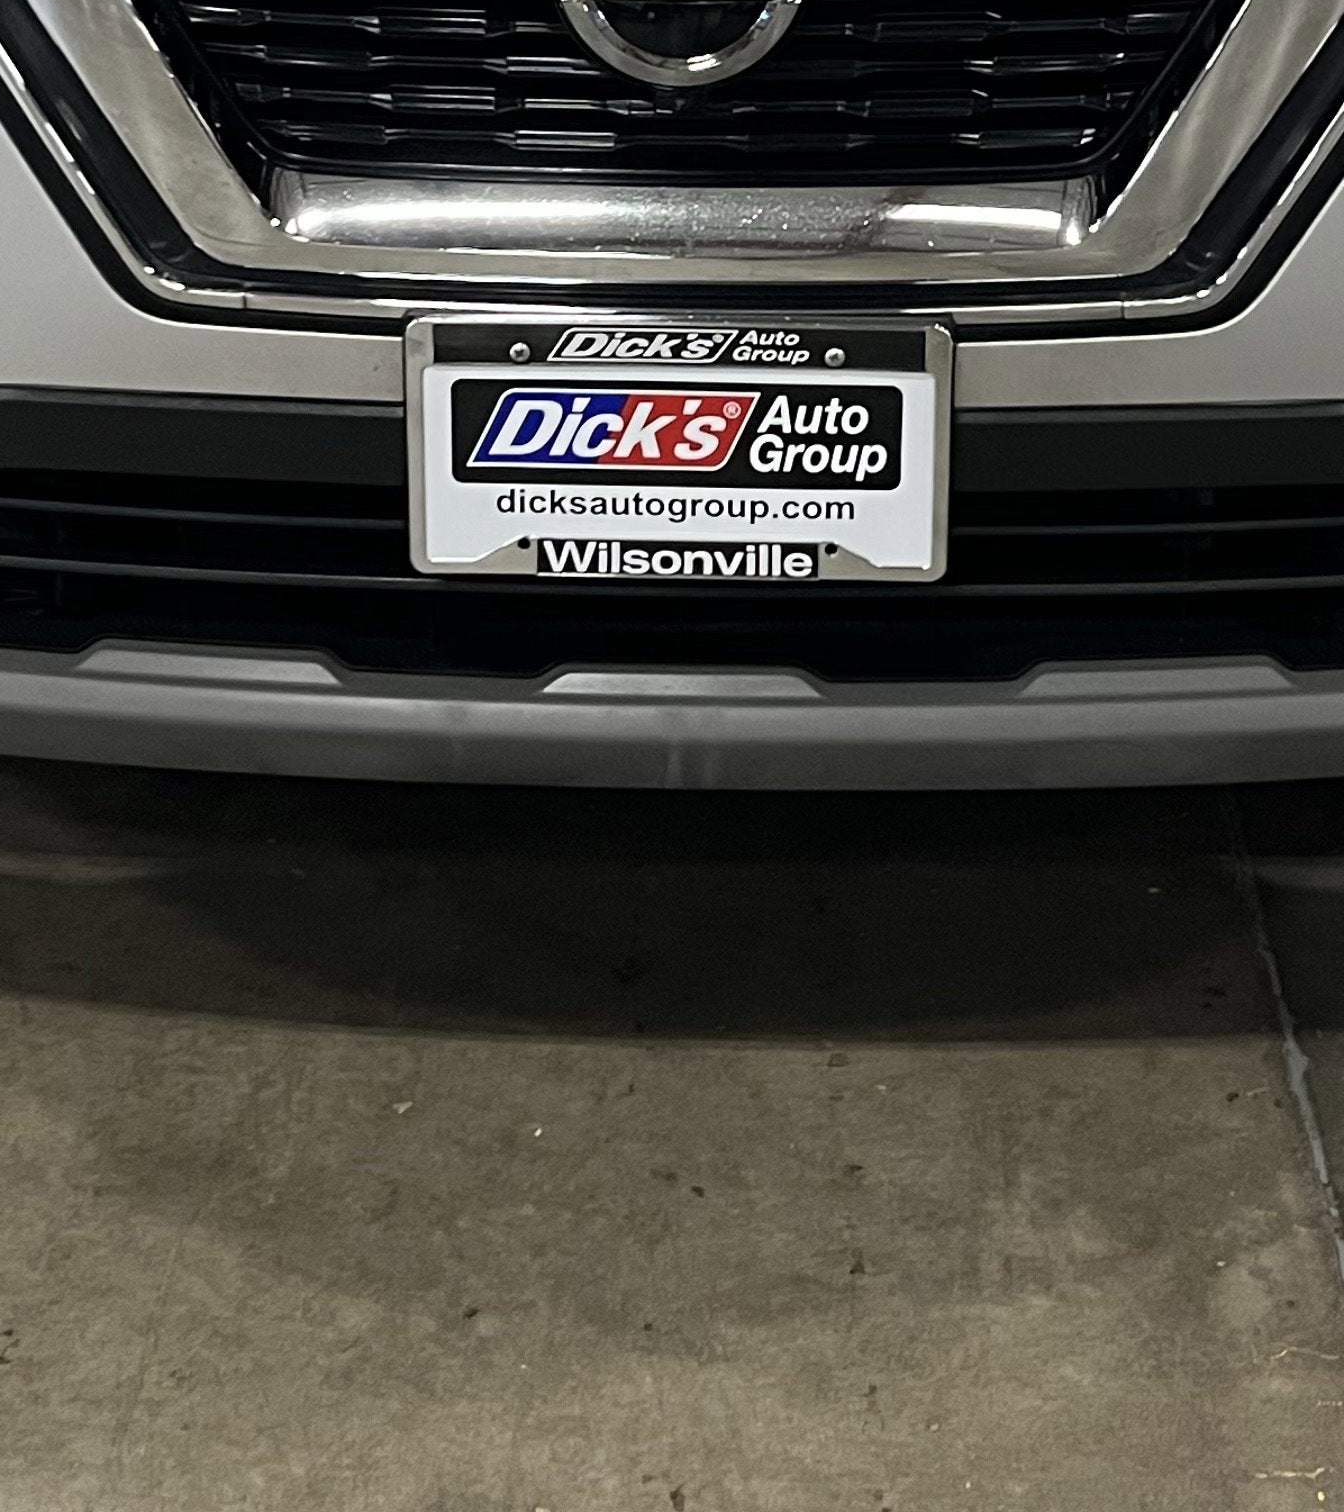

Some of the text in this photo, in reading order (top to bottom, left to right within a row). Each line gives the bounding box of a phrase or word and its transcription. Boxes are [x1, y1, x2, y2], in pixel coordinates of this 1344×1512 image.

[559, 330, 800, 360] Dick's Auto
[731, 345, 811, 366] Group
[488, 395, 870, 461] Dick's Auto
[749, 433, 888, 482] Group
[495, 489, 856, 525] dicksautogroup.com
[542, 540, 814, 578] Wilsonville
